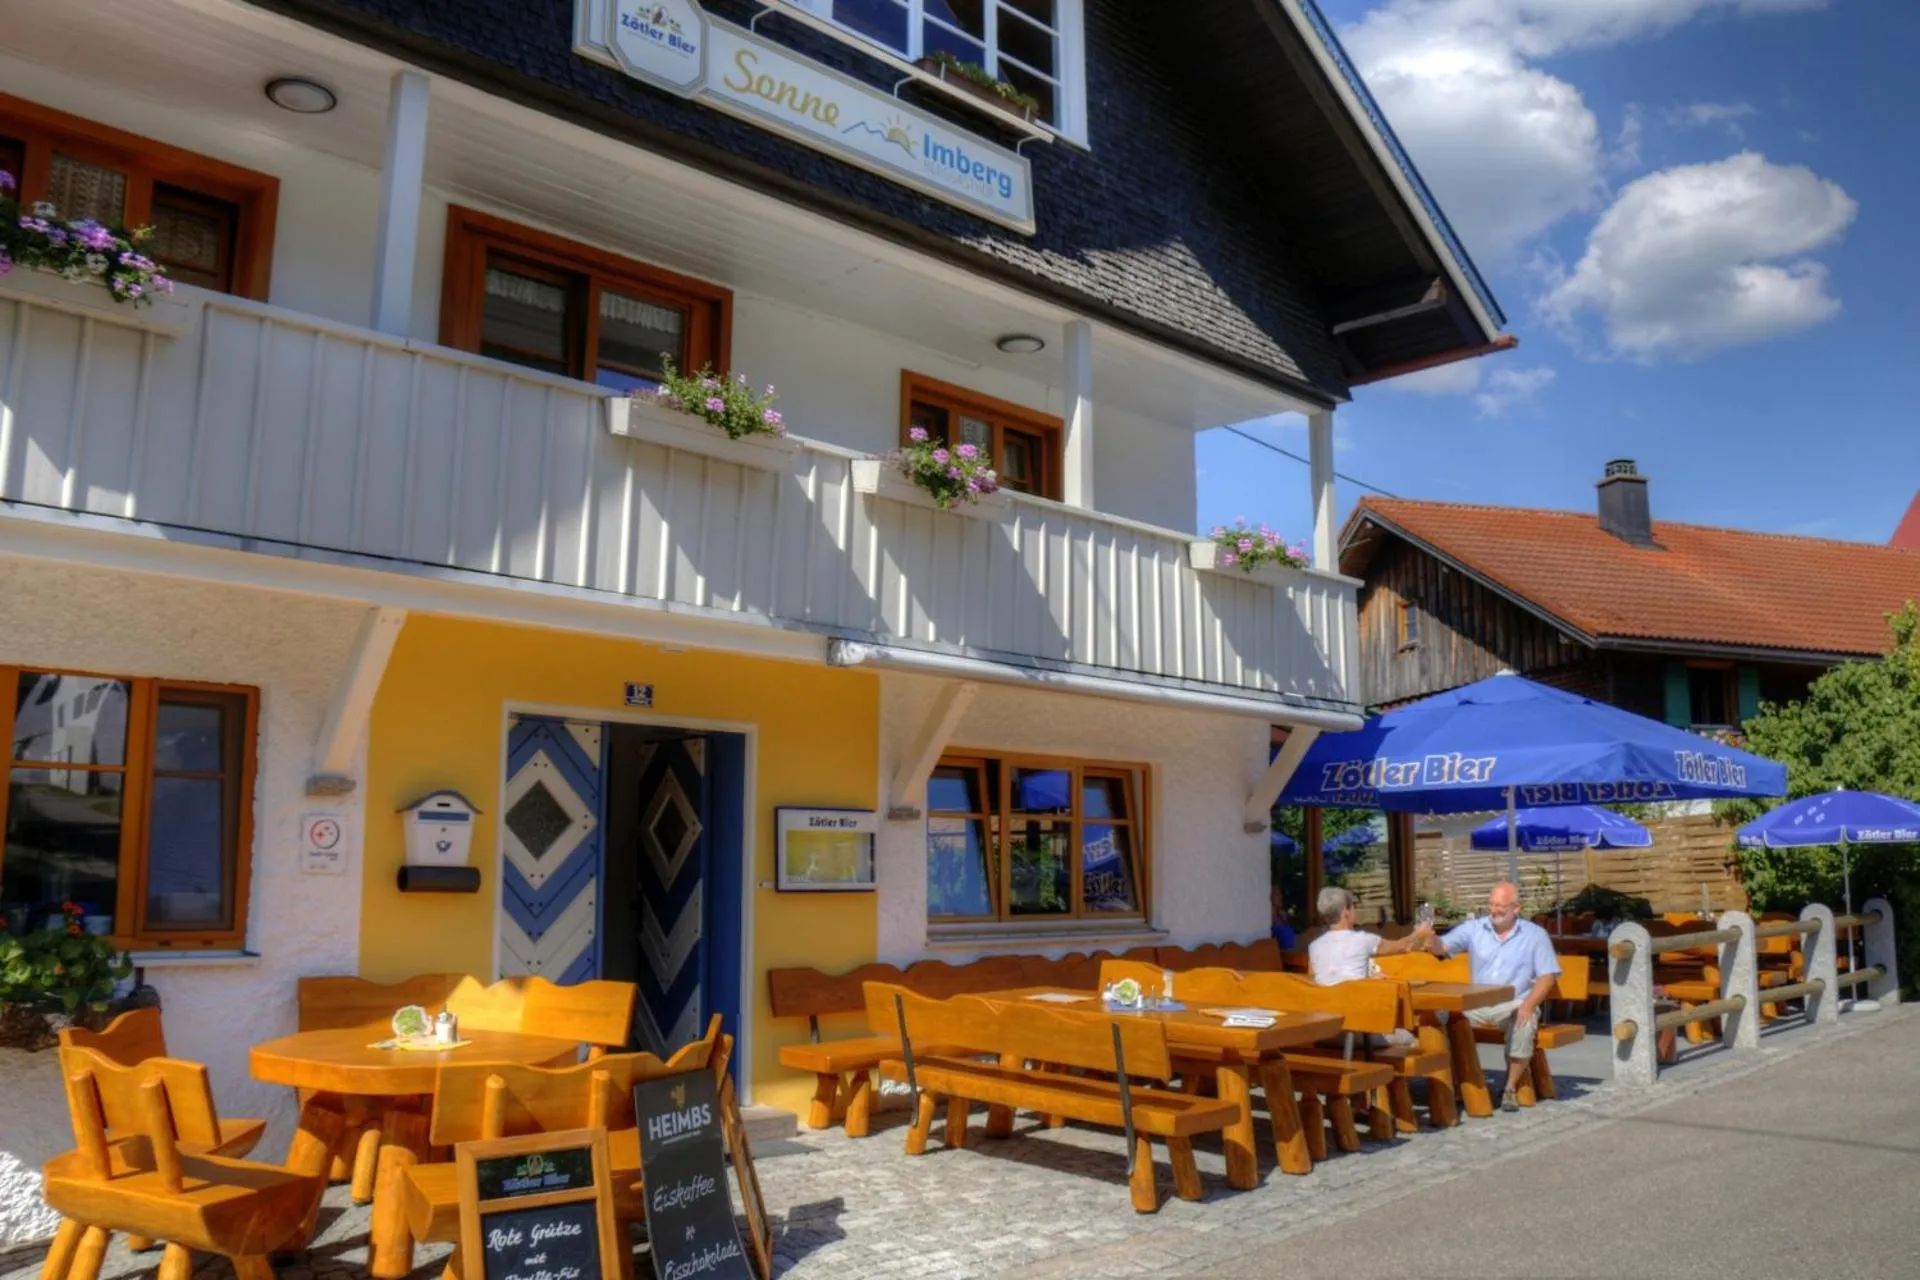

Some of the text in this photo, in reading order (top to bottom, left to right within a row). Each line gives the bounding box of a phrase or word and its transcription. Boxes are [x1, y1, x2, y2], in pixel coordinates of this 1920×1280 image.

[621, 12, 664, 41] Zötler
[668, 32, 697, 55] Bier
[723, 48, 840, 128] Sonne
[923, 132, 1013, 199] Imberg
[1320, 751, 1497, 792] Zötler Bier
[1673, 750, 1746, 789] Zötler Bier
[1894, 828, 1919, 839] Bier
[648, 1103, 712, 1141] HEIMBS
[653, 1174, 716, 1213] Eiskaffee
[486, 1221, 582, 1252] Rote Grütze
[663, 1240, 741, 1280] Eisschokolade
